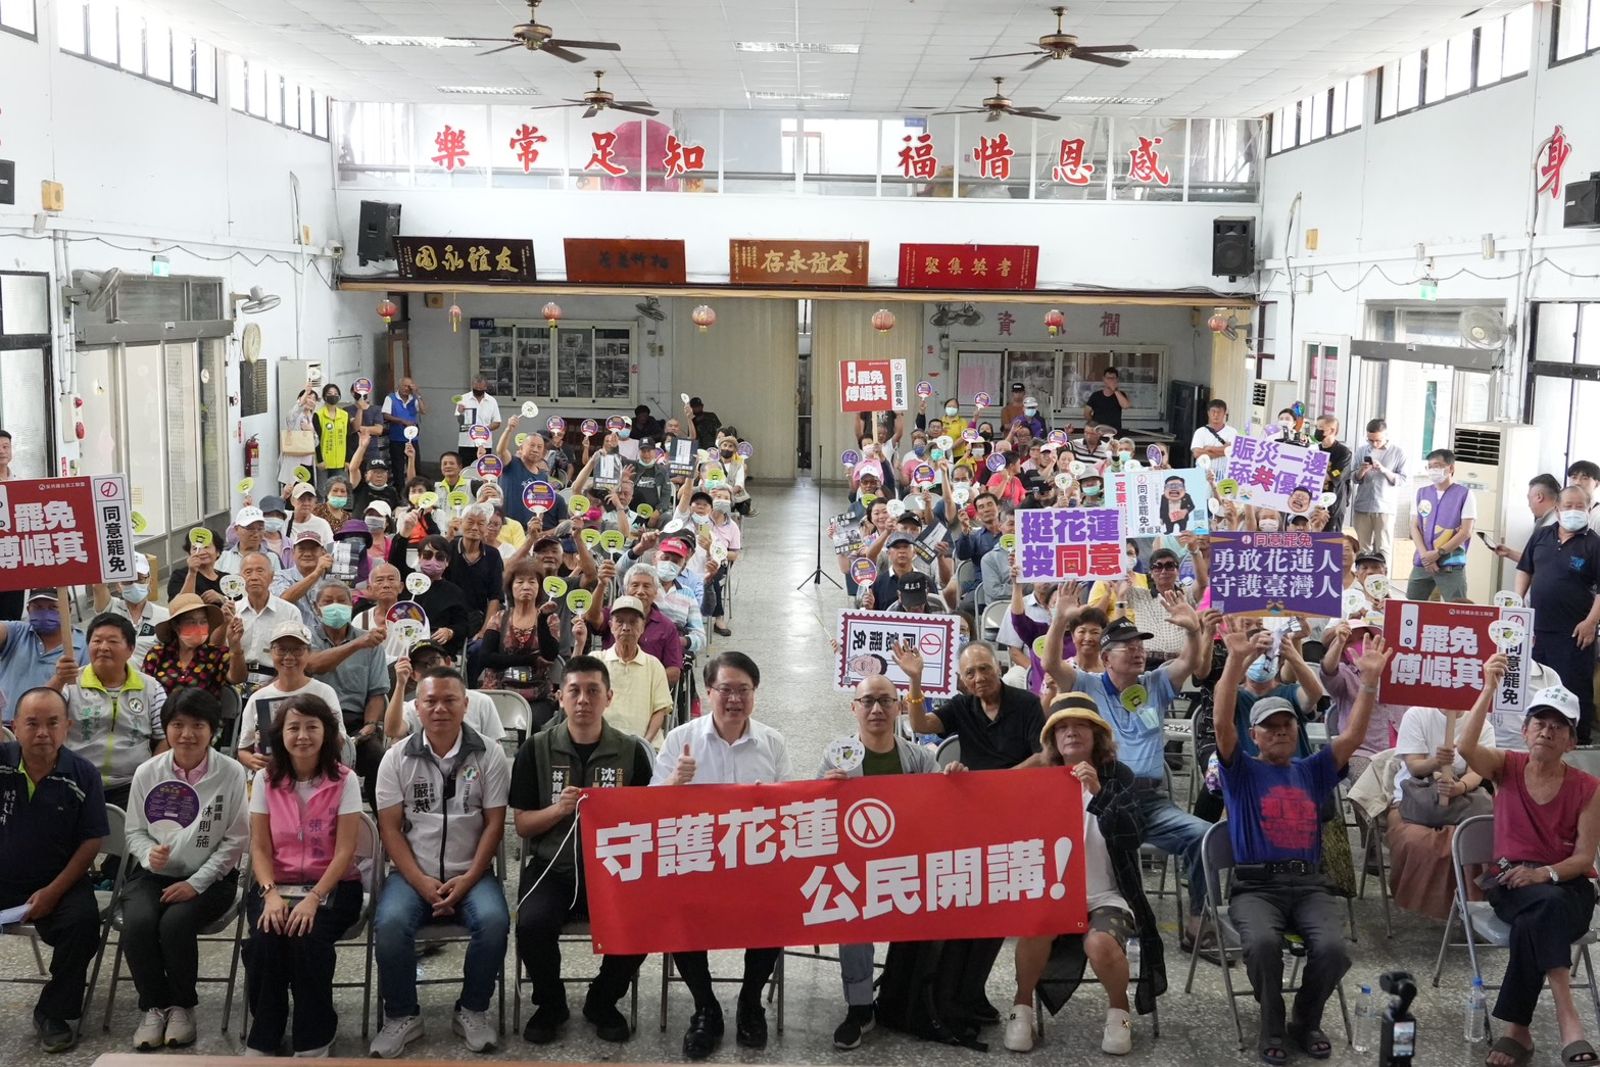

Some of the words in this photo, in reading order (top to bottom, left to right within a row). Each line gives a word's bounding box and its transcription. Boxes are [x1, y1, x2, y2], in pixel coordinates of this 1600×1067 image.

[1537, 125, 1572, 199] 身
[997, 310, 1121, 338] 資欄
[1231, 435, 1328, 478] 賑災一邊
[14, 500, 77, 532] 罷免
[1021, 508, 1120, 544] 挺花蓮
[103, 505, 127, 573] 同意罷免
[1253, 533, 1313, 547] 同意罷免
[1022, 543, 1122, 578] 投同意
[1212, 549, 1341, 573] 勇敢花蓮人
[1211, 573, 1341, 599] 守護臺灣人
[1421, 624, 1479, 655] 罷免
[595, 798, 839, 883] 守護花蓮
[800, 836, 1073, 927] 公民開講!
